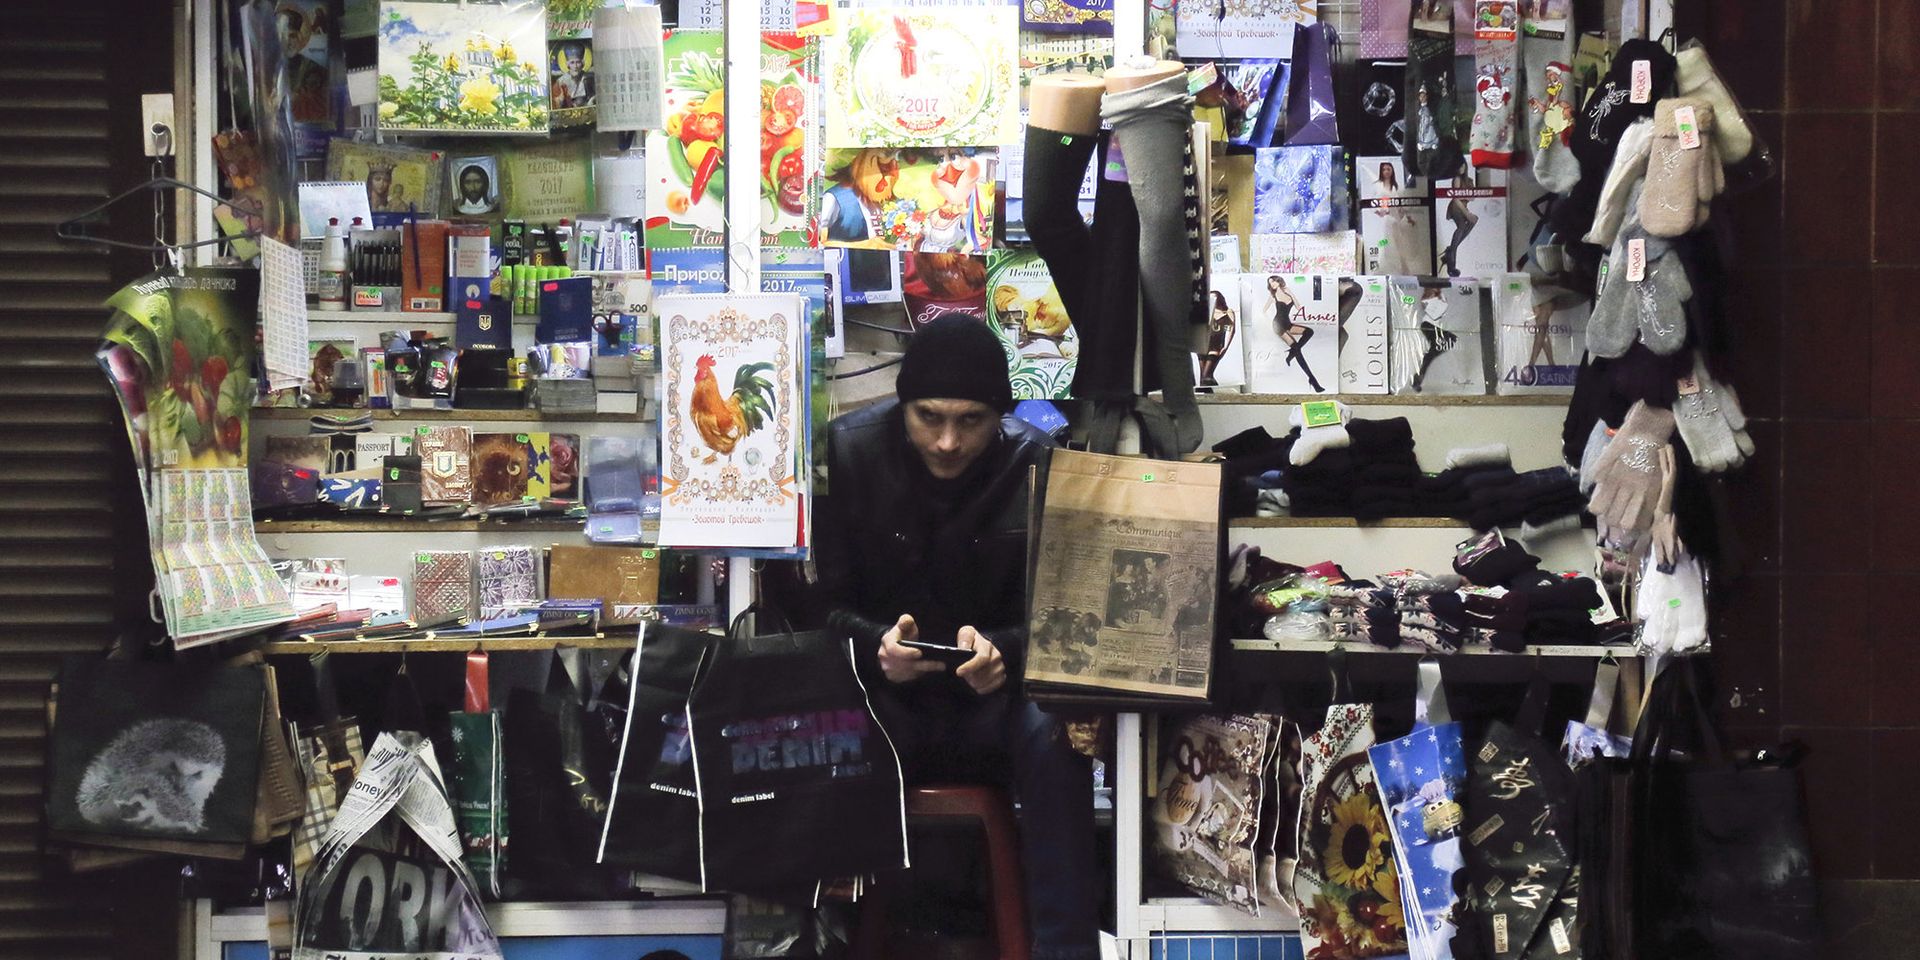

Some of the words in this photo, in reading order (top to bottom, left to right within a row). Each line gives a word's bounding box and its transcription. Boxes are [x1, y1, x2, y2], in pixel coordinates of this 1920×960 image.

[700, 6, 711, 15] 12
[780, 7, 791, 15] 16
[700, 17, 711, 25] 19
[779, 17, 791, 25] 23
[905, 98, 939, 113] 2017
[540, 176, 563, 195] 2017
[763, 280, 794, 292] 2017
[844, 295, 867, 303] SLIM
[629, 304, 648, 314] 500
[1292, 306, 1337, 322] Annes
[1367, 315, 1384, 389] LORES
[1043, 360, 1062, 369] 2017
[357, 443, 389, 452] PASSPORT
[730, 730, 862, 775] DENIM
[352, 777, 384, 800] oney
[650, 781, 677, 794] denim
[731, 794, 755, 804] denim
[756, 791, 775, 802] label
